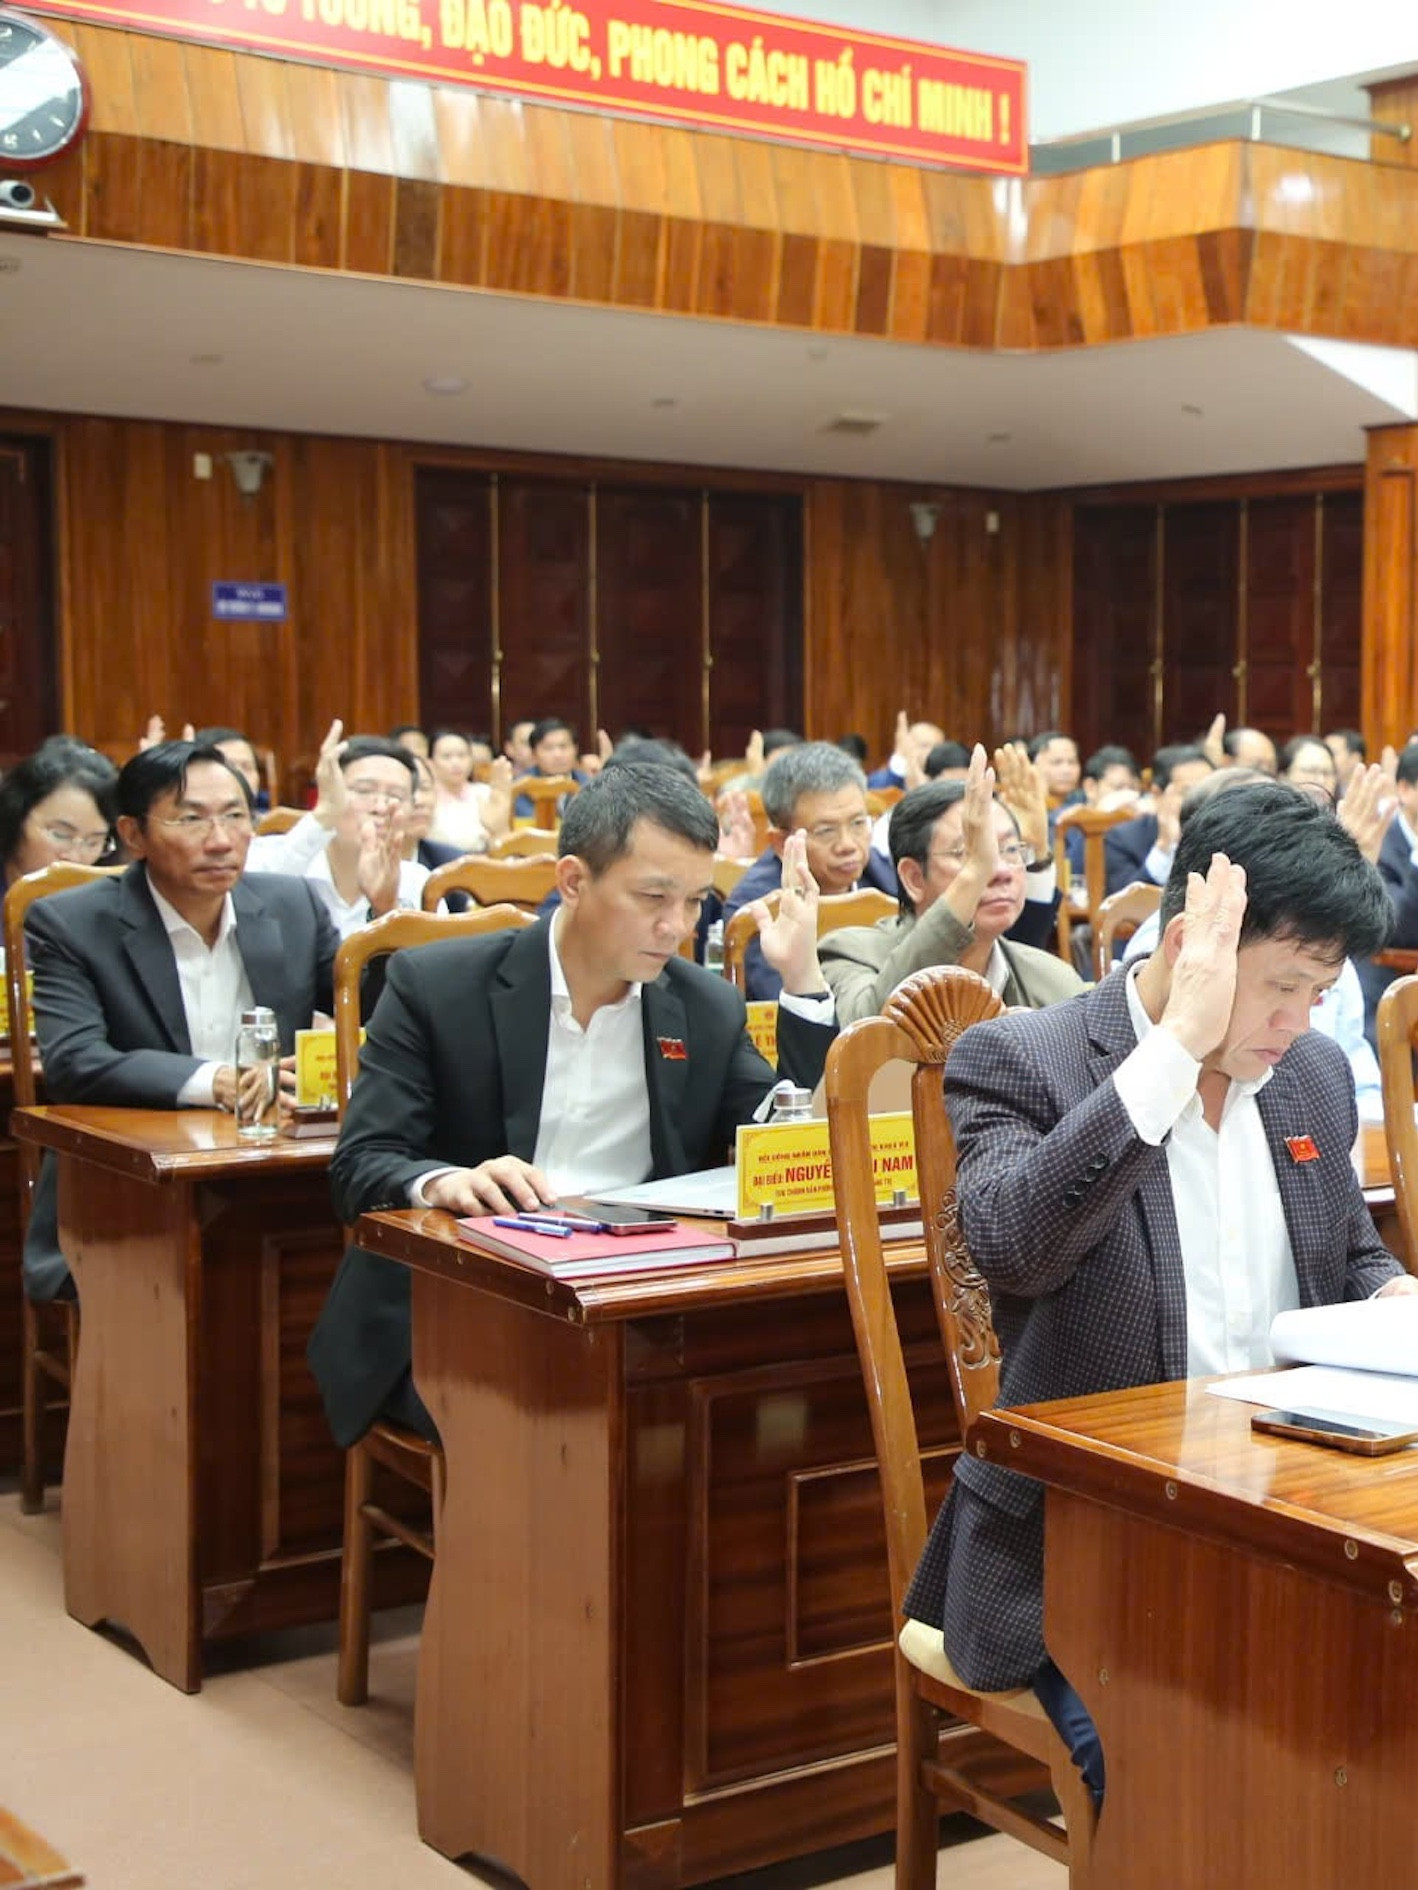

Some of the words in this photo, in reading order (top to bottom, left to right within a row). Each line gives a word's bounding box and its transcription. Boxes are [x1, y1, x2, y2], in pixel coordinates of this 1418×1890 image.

[608, 19, 719, 95] PHONG
[726, 36, 808, 111] CÁCH
[862, 64, 912, 129] CHÍ
[918, 77, 993, 142] MINH
[882, 1155, 913, 1172] NAM
